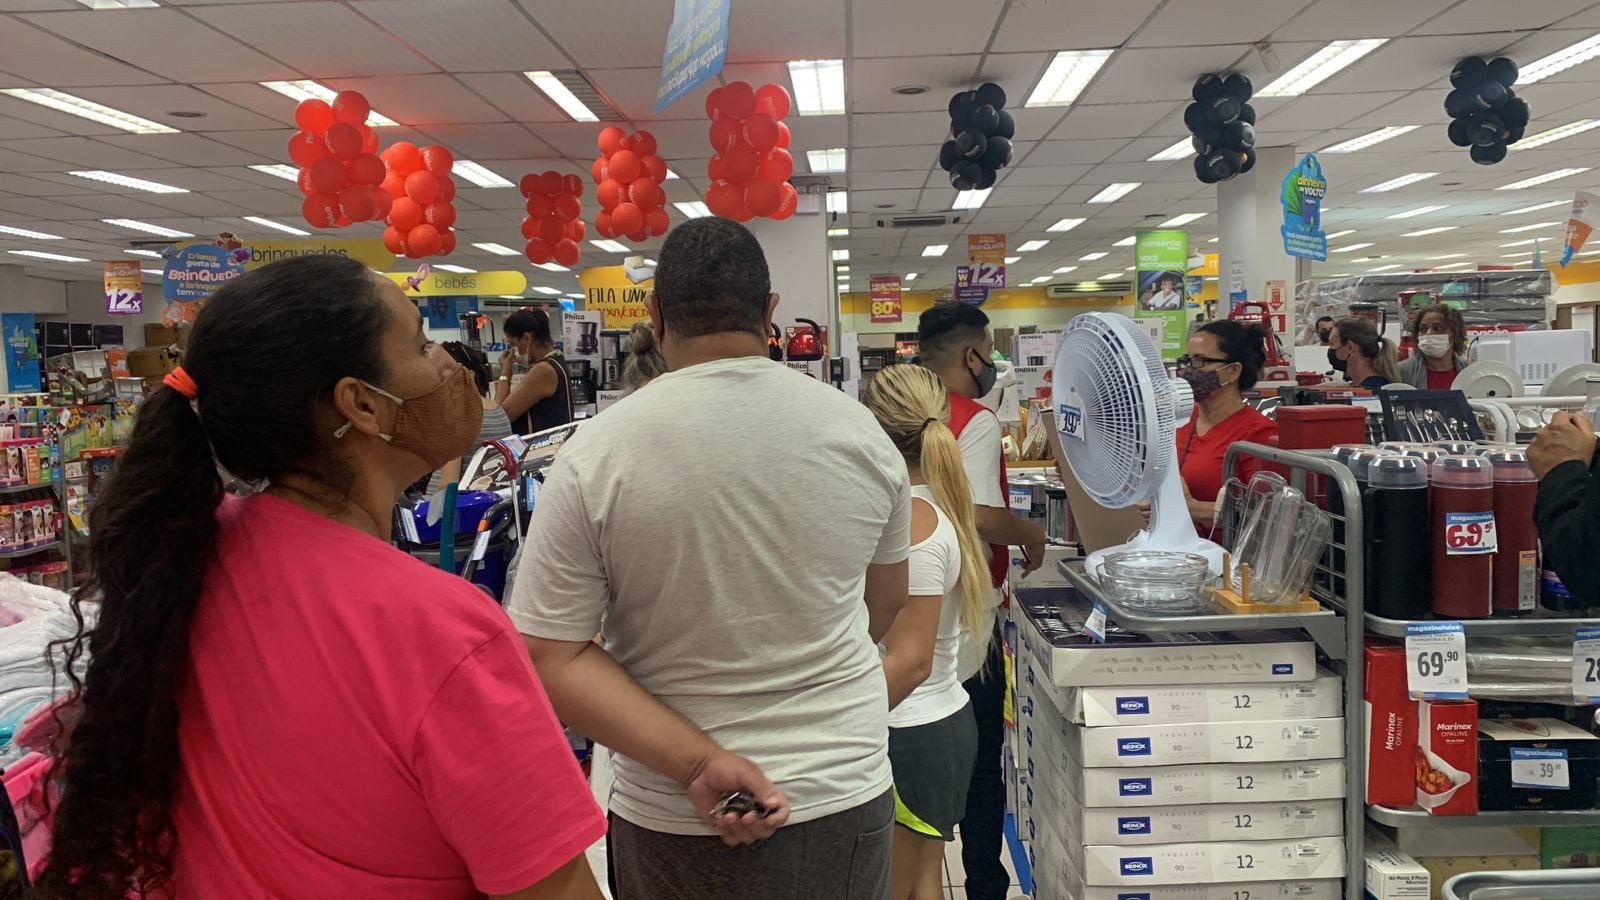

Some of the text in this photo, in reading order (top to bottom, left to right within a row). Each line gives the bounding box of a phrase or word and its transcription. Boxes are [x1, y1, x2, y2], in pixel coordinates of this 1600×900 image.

[434, 275, 477, 289] bebês
[589, 288, 647, 304] FILA UNI
[1408, 624, 1461, 633] magazineluiza
[1233, 695, 1251, 708] 12
[1385, 712, 1396, 750] Marinex
[1395, 717, 1404, 746] OPALINE
[1437, 722, 1472, 731] Marinex
[1235, 736, 1253, 749] 12
[1237, 776, 1254, 789] 12
[1235, 815, 1252, 827] 12
[1237, 855, 1254, 868] 12
